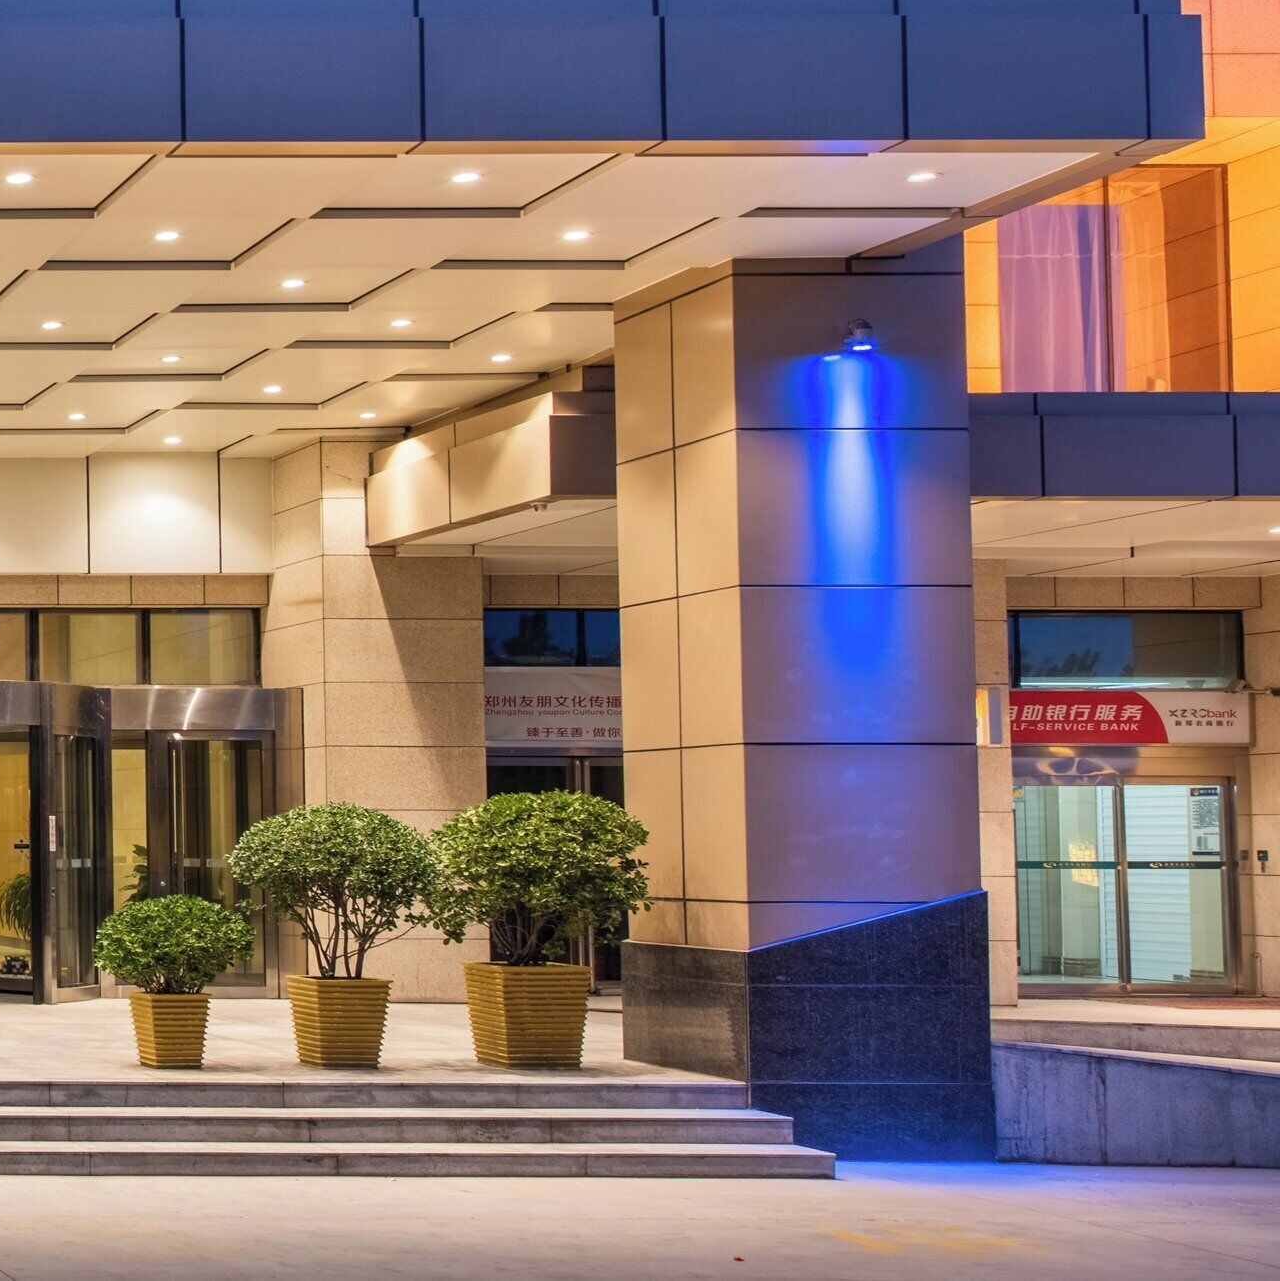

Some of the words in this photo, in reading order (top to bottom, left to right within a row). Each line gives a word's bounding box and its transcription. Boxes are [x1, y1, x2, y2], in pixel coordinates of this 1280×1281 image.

[484, 695, 622, 708] 郑州友朋文化传播
[1100, 722, 1139, 731] BANK
